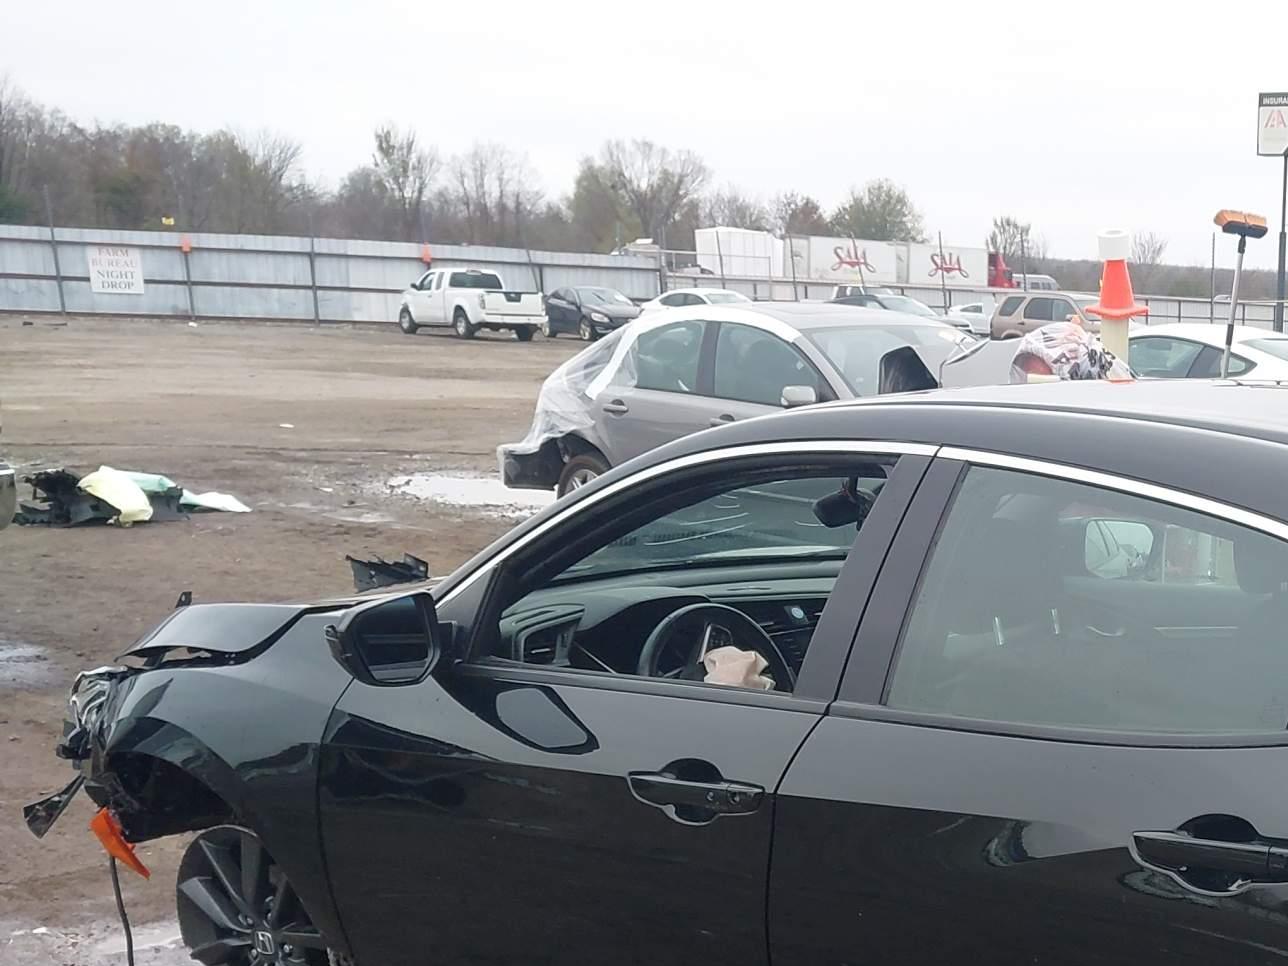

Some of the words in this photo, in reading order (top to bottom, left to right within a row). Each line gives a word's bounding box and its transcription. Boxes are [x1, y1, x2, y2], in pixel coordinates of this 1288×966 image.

[97, 247, 129, 257] FARM
[97, 270, 135, 280] NIGHT
[101, 280, 134, 290] DROP
